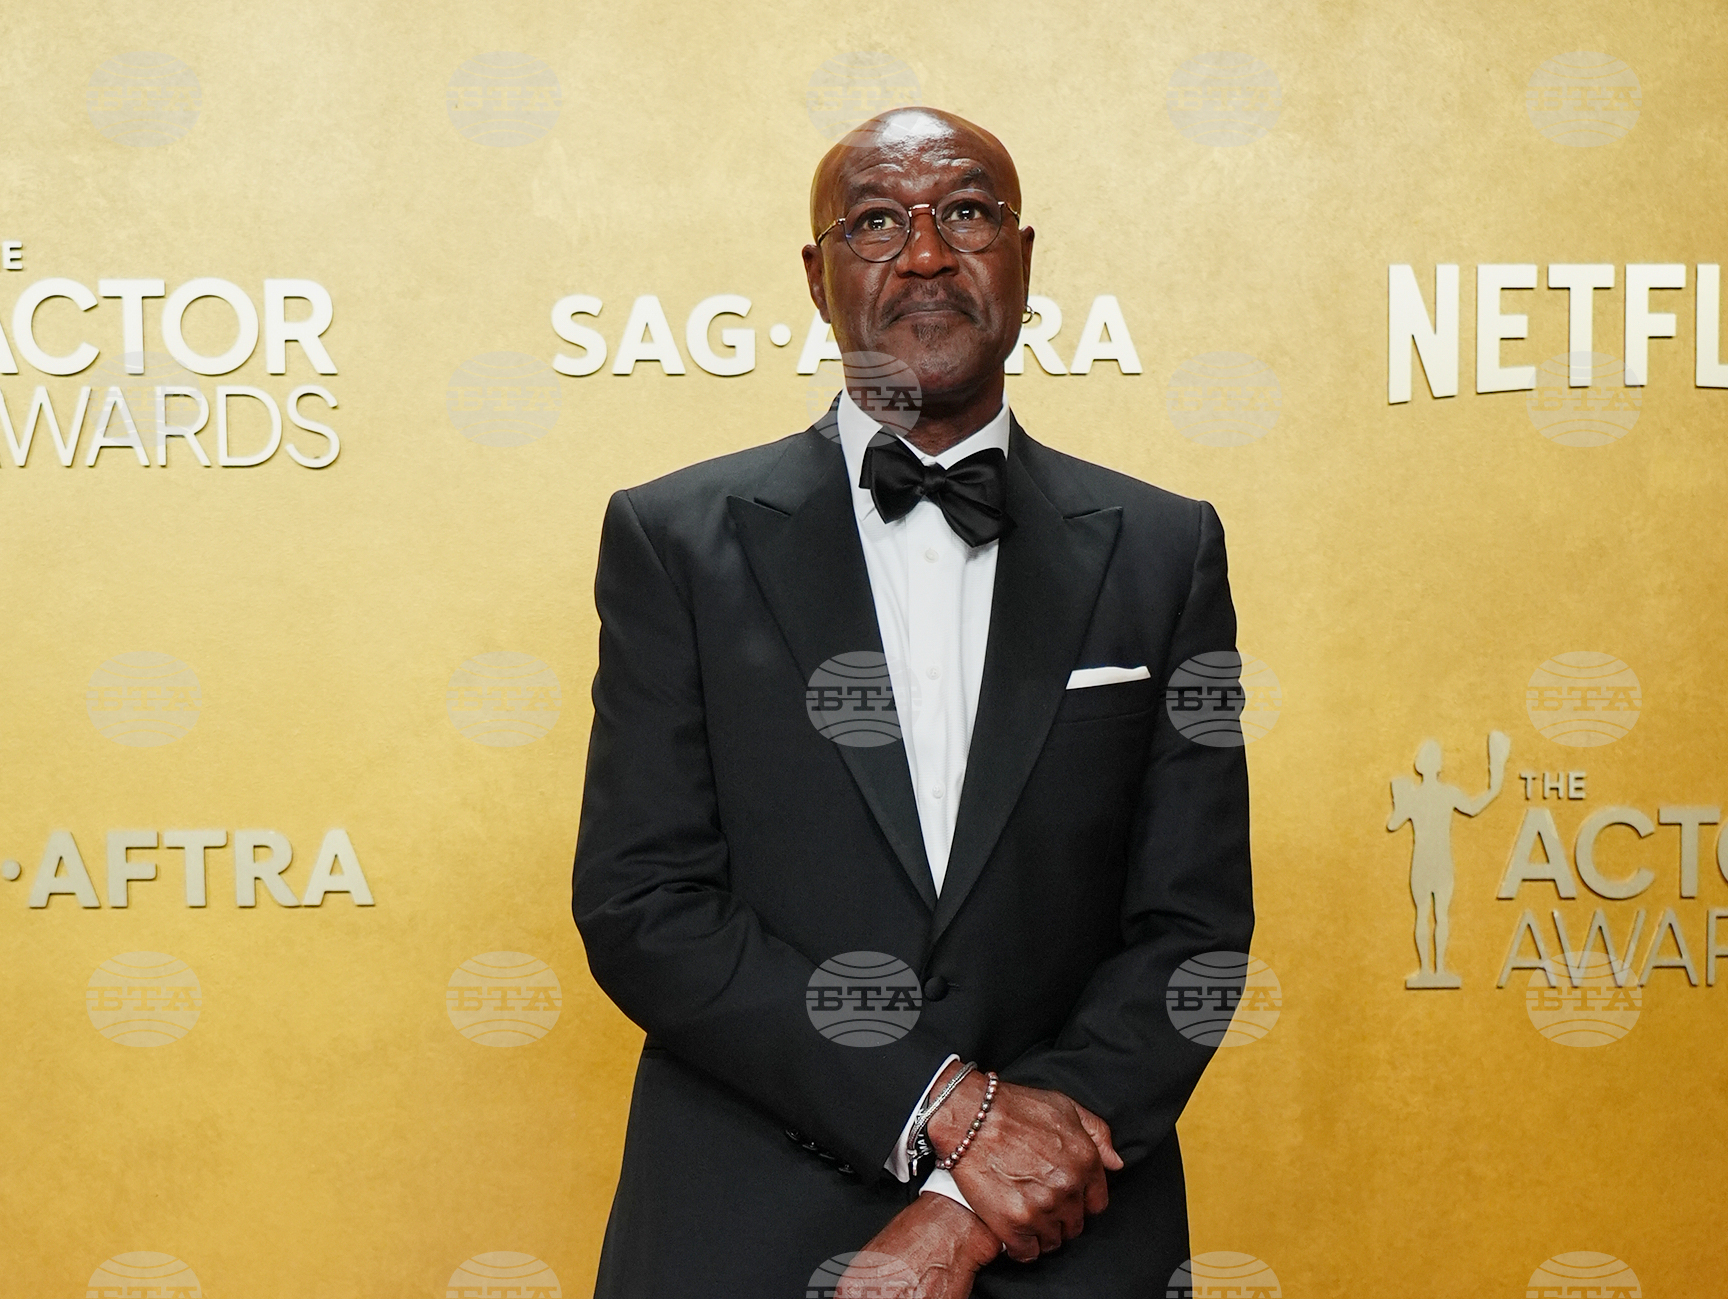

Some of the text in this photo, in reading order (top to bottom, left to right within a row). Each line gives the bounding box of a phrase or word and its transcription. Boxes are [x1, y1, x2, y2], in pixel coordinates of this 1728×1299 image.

[0, 277, 338, 375] CTOR
[1388, 264, 1728, 404] NETFL
[0, 385, 341, 468] WARDS
[1519, 771, 1586, 800] THE
[1496, 805, 1728, 900] ACT
